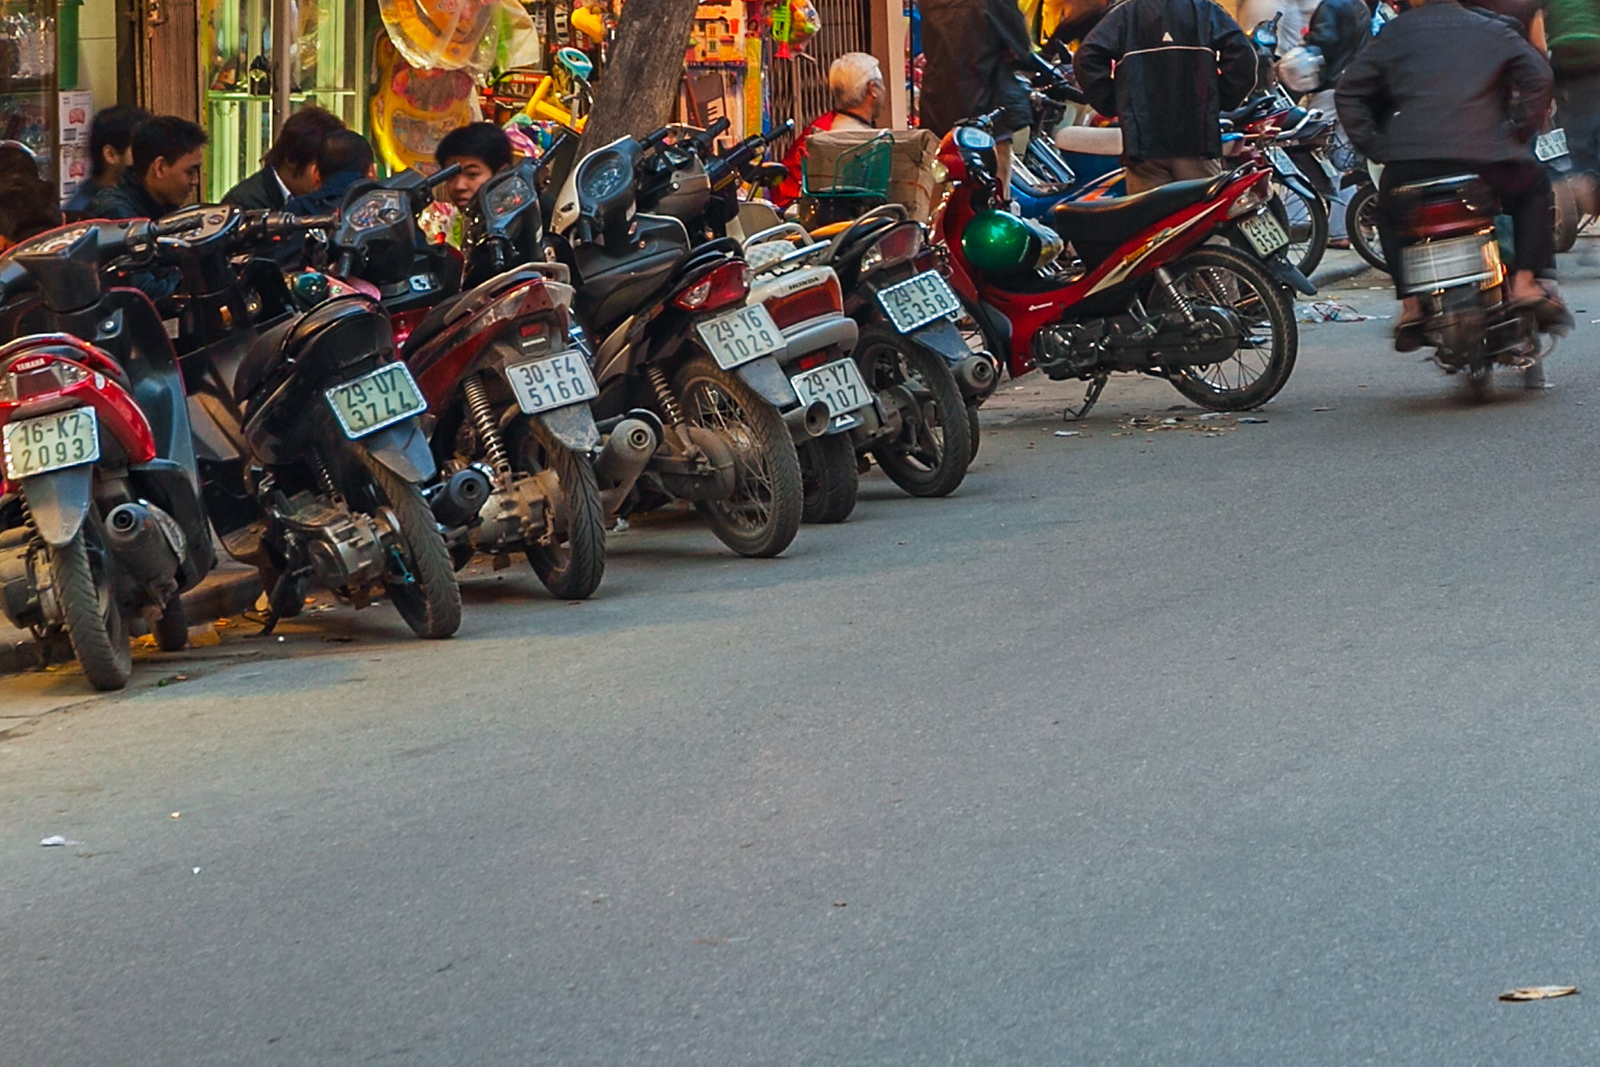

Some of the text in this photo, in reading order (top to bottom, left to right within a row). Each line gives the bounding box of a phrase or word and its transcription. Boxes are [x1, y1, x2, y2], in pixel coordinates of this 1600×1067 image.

[1256, 228, 1285, 252] 3597
[788, 276, 820, 291] HONDA
[892, 277, 937, 308] 29-V3
[901, 293, 948, 326] 5358
[710, 310, 763, 342] 29-Y6
[724, 329, 775, 362] 1029
[16, 357, 46, 371] YAMAHA
[519, 356, 577, 386] 30-F4
[802, 363, 850, 395] 29-Y7
[529, 377, 586, 407] 5160
[352, 391, 412, 429] 3744
[21, 415, 80, 446] 16-K7
[22, 438, 84, 472] 2093
